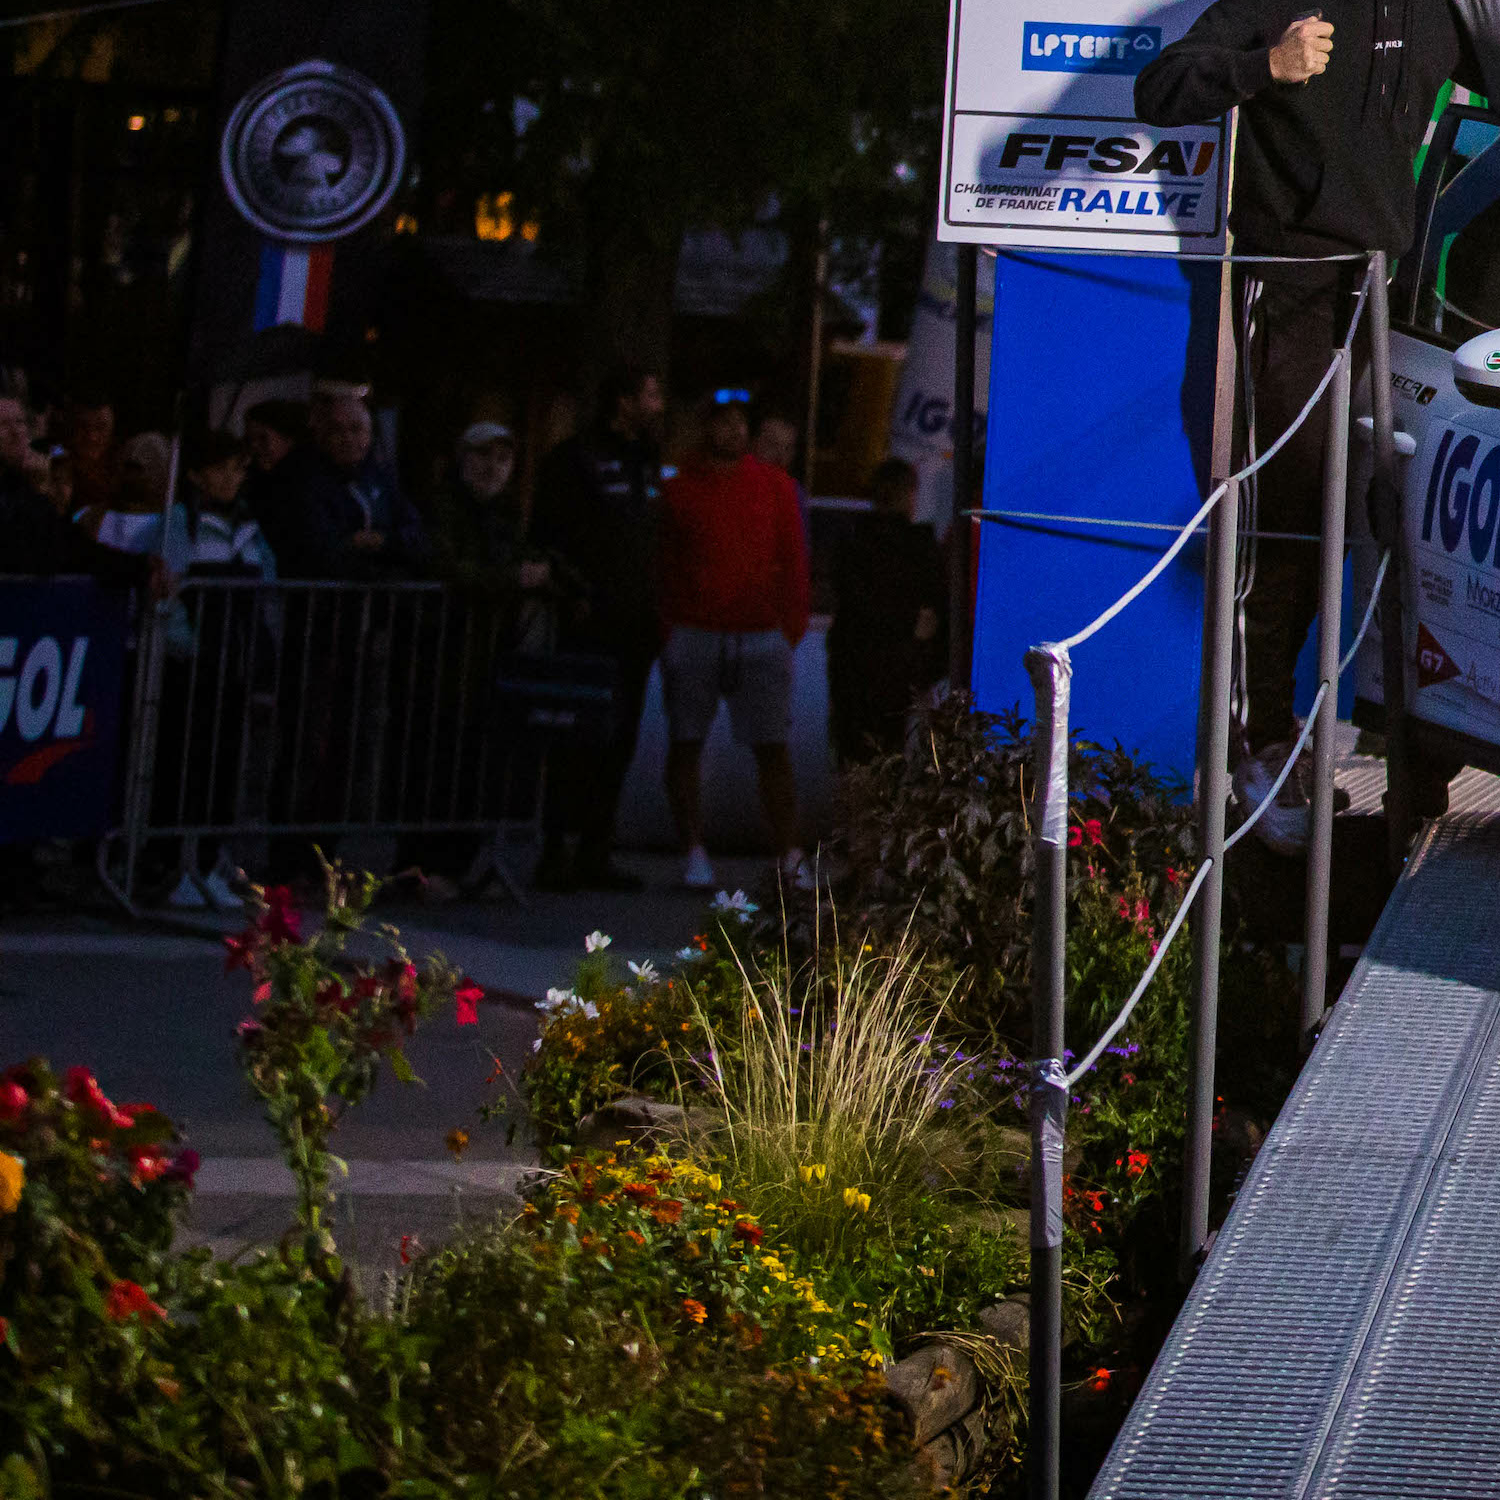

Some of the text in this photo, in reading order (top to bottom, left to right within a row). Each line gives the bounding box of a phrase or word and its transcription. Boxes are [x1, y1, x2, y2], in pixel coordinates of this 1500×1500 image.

[1028, 31, 1131, 61] LPTENT
[998, 132, 1191, 177] FFSA
[954, 182, 1061, 200] CHAMPIONNAT
[975, 188, 1203, 219] DE FRANCE RALLYE
